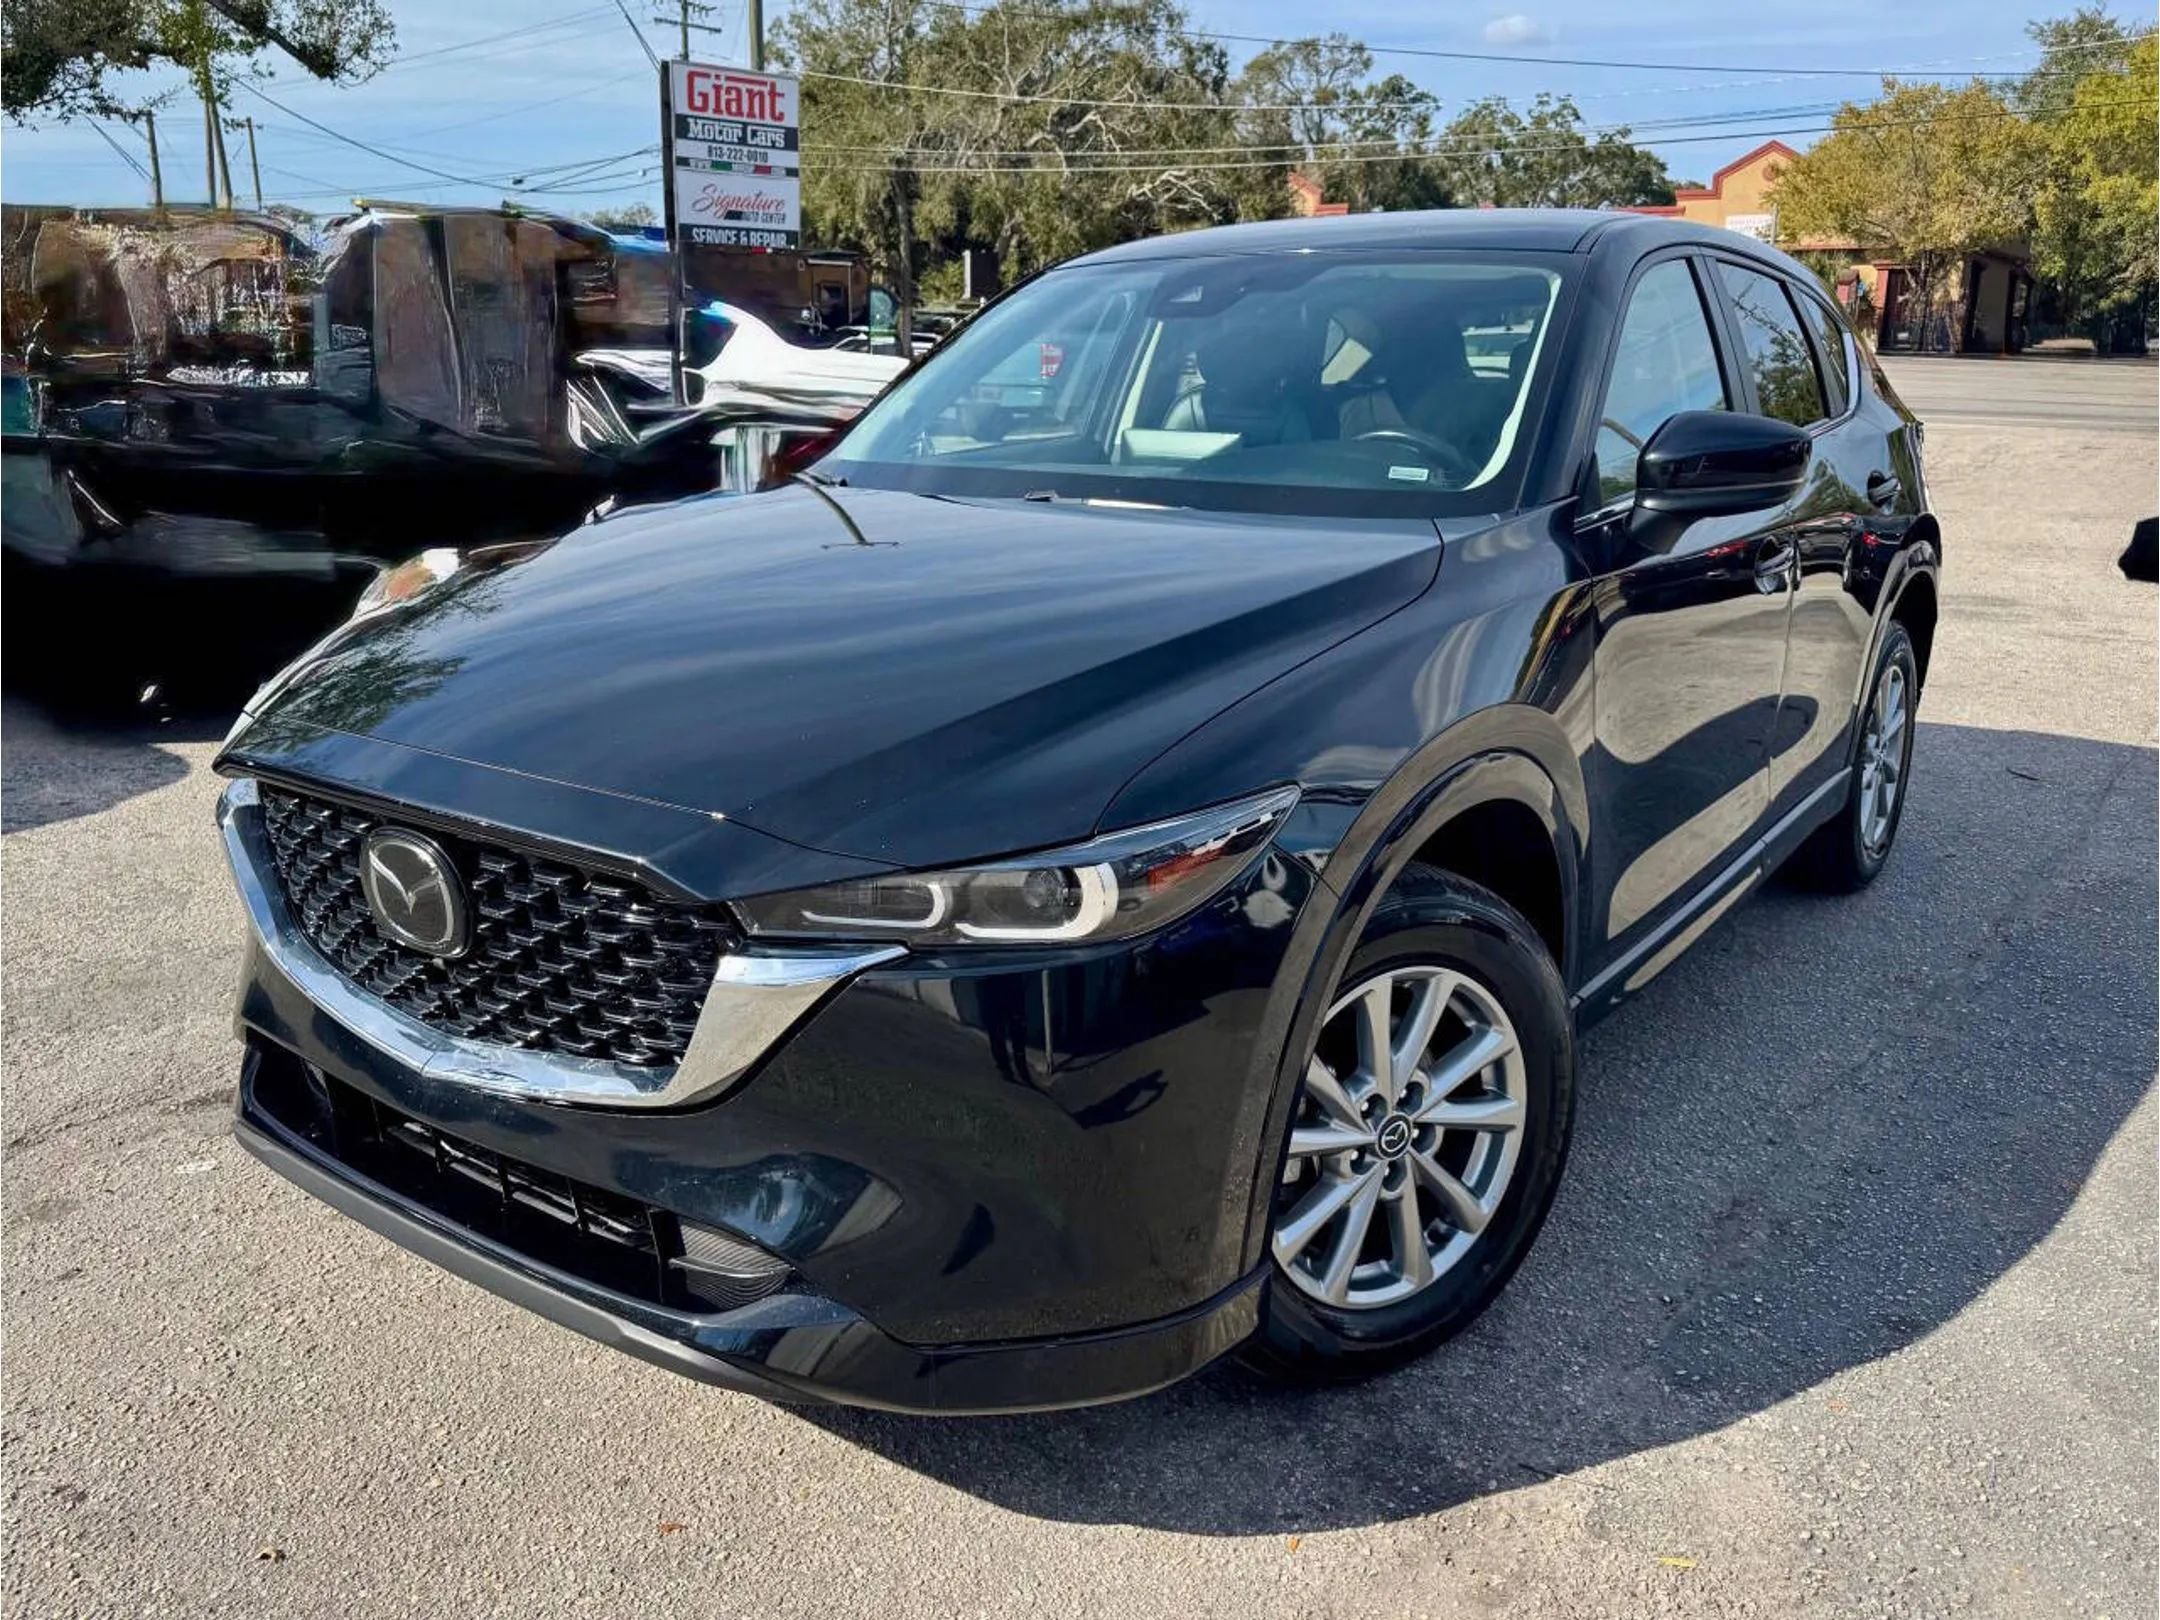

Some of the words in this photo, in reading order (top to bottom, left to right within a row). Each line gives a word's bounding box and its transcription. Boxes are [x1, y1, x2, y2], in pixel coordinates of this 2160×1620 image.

[687, 70, 785, 122] Giant
[687, 117, 743, 143] Motor
[747, 125, 786, 148] Cars
[691, 183, 786, 219] Signature
[692, 227, 738, 245] SERVICE
[749, 230, 788, 247] REPAIR
